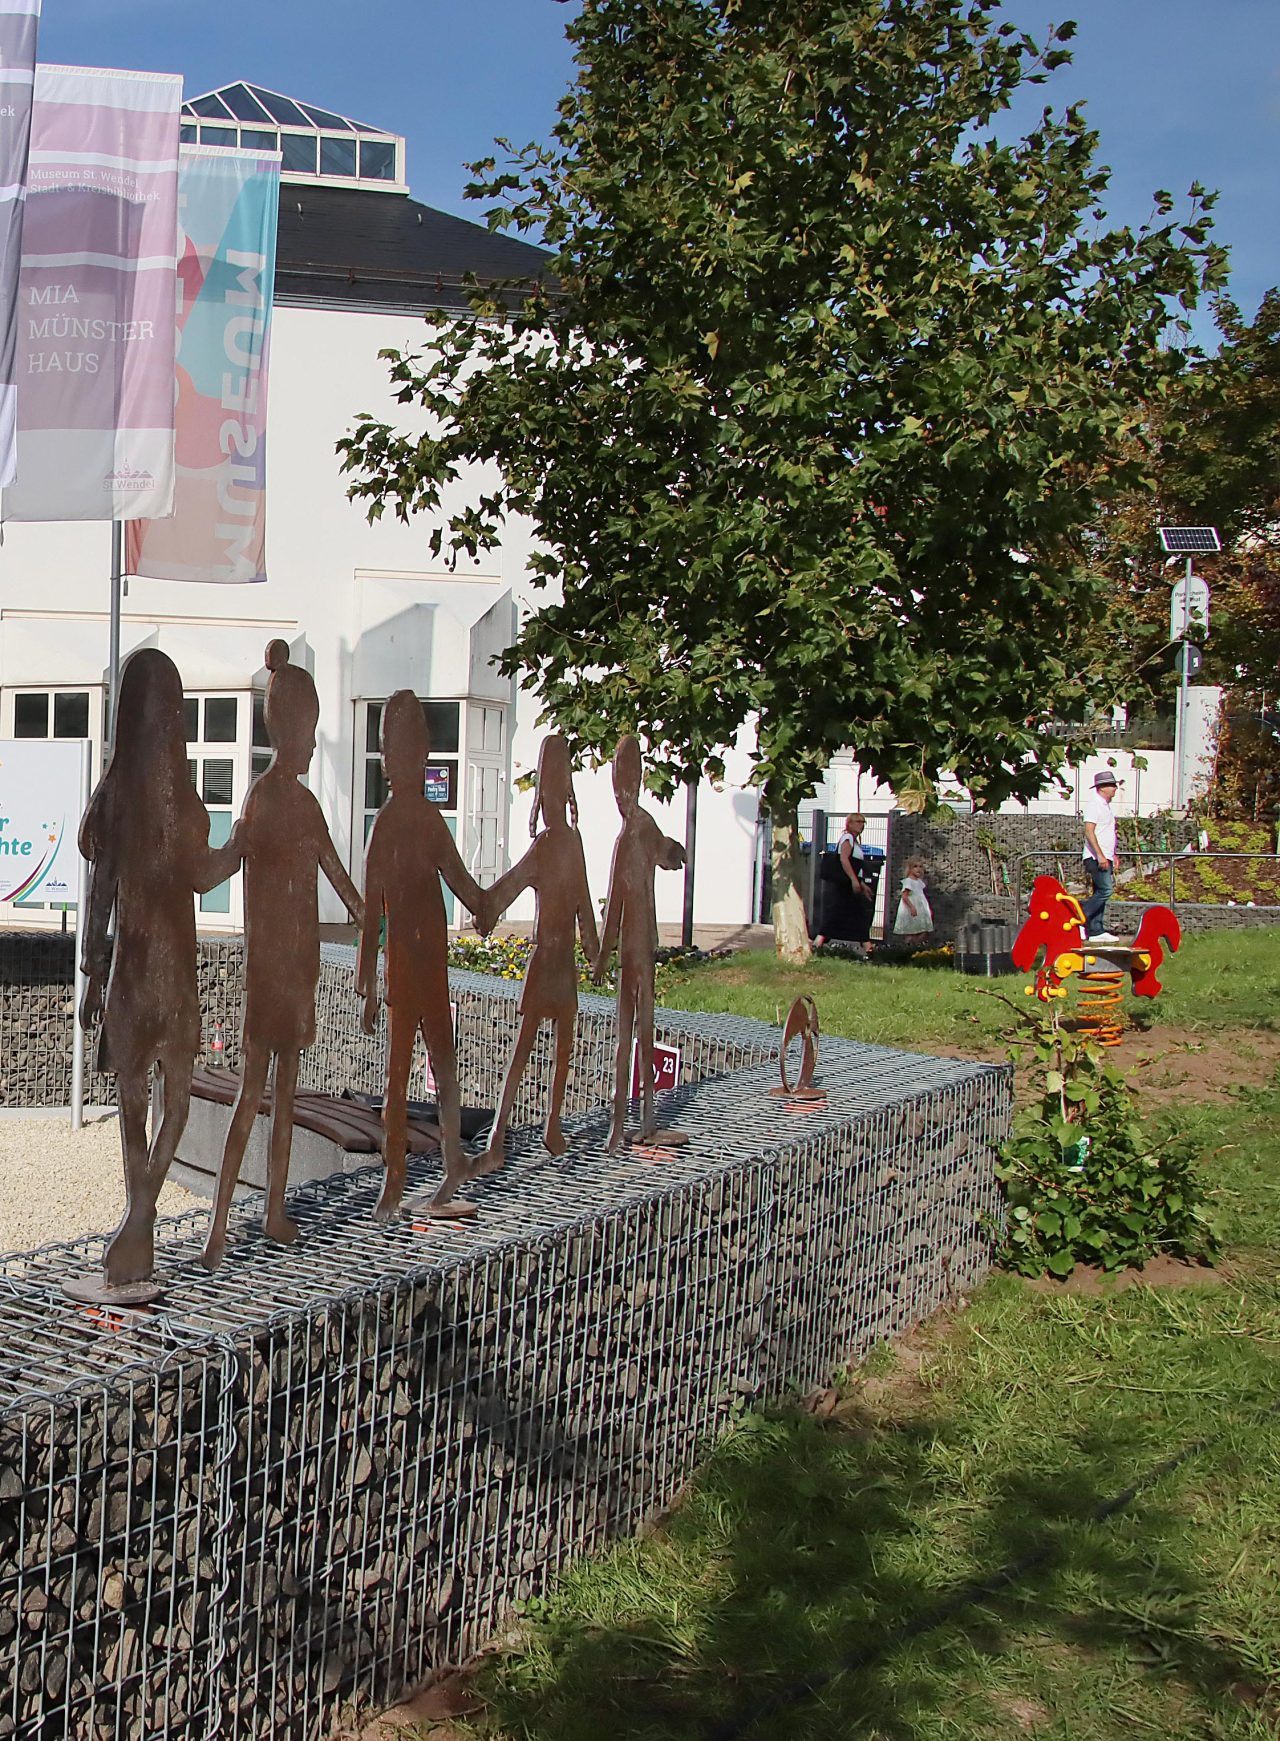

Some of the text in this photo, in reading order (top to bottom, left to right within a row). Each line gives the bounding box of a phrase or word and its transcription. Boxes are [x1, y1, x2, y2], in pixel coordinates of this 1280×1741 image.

[30, 168, 140, 189] Museum St. Wendel
[67, 182, 76, 193] &
[77, 182, 161, 202] Kreisbibliothek
[27, 283, 80, 305] MIA
[27, 312, 155, 342] MÜNSTER
[27, 350, 100, 374] HAUS
[662, 1056, 674, 1074] 23
